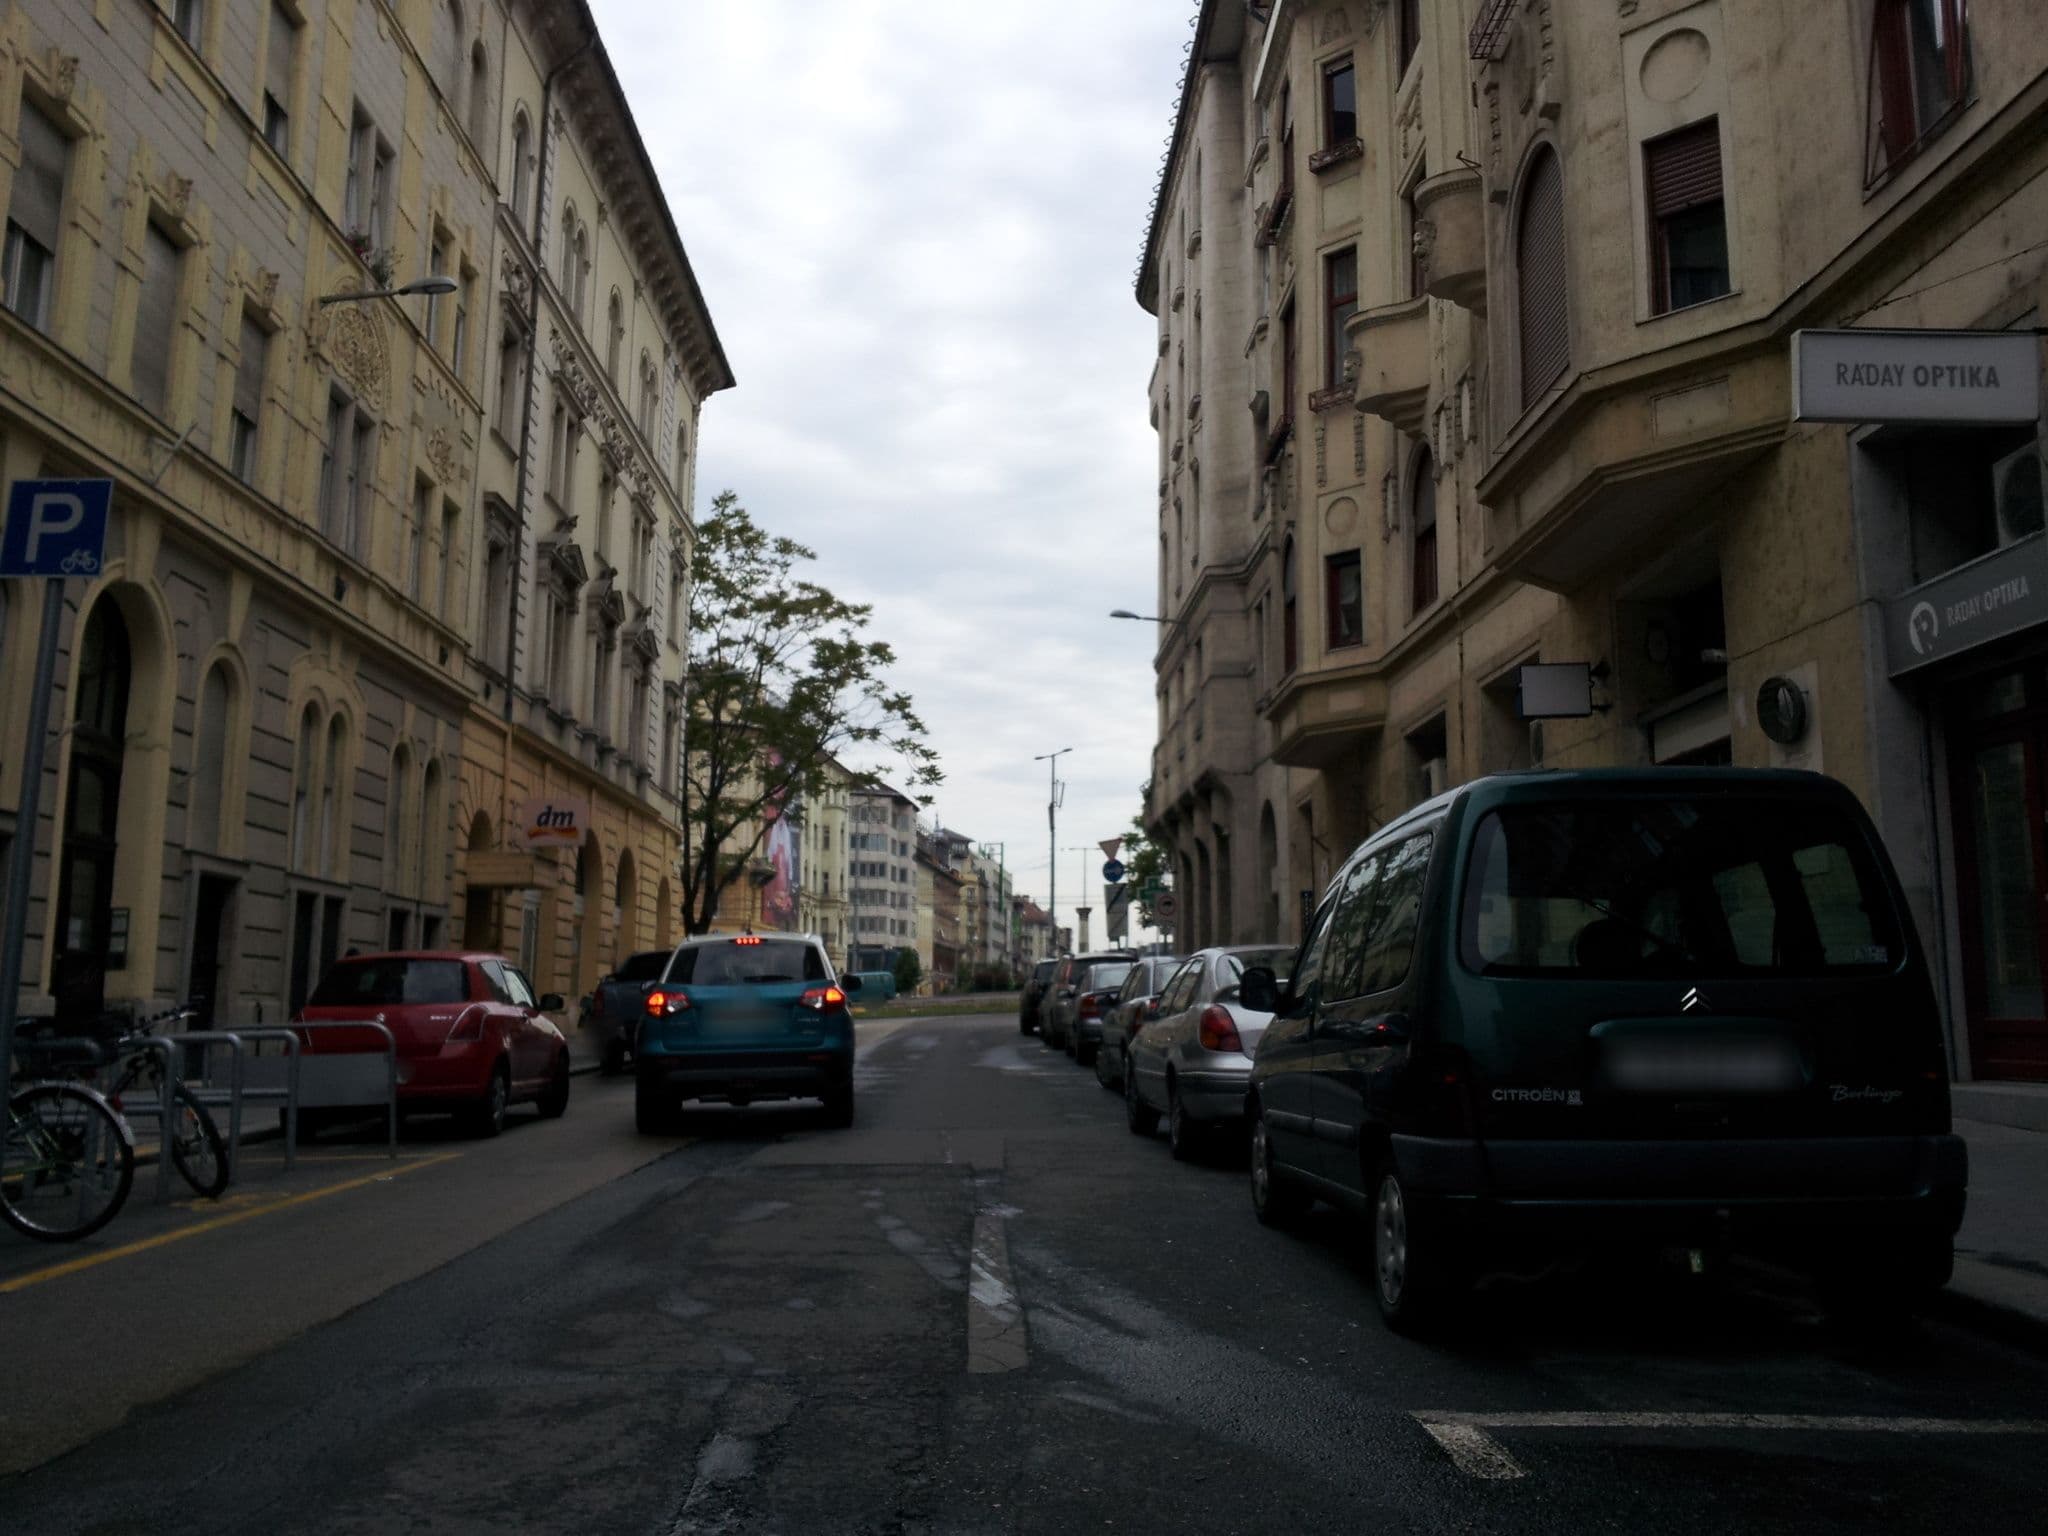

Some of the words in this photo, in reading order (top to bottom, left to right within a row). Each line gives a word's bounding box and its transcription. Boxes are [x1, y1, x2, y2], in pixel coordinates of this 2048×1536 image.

[1912, 364, 2001, 388] OPTIKA
[24, 492, 84, 563] P
[1983, 575, 2031, 612] OPTIKA
[536, 805, 574, 827] dm
